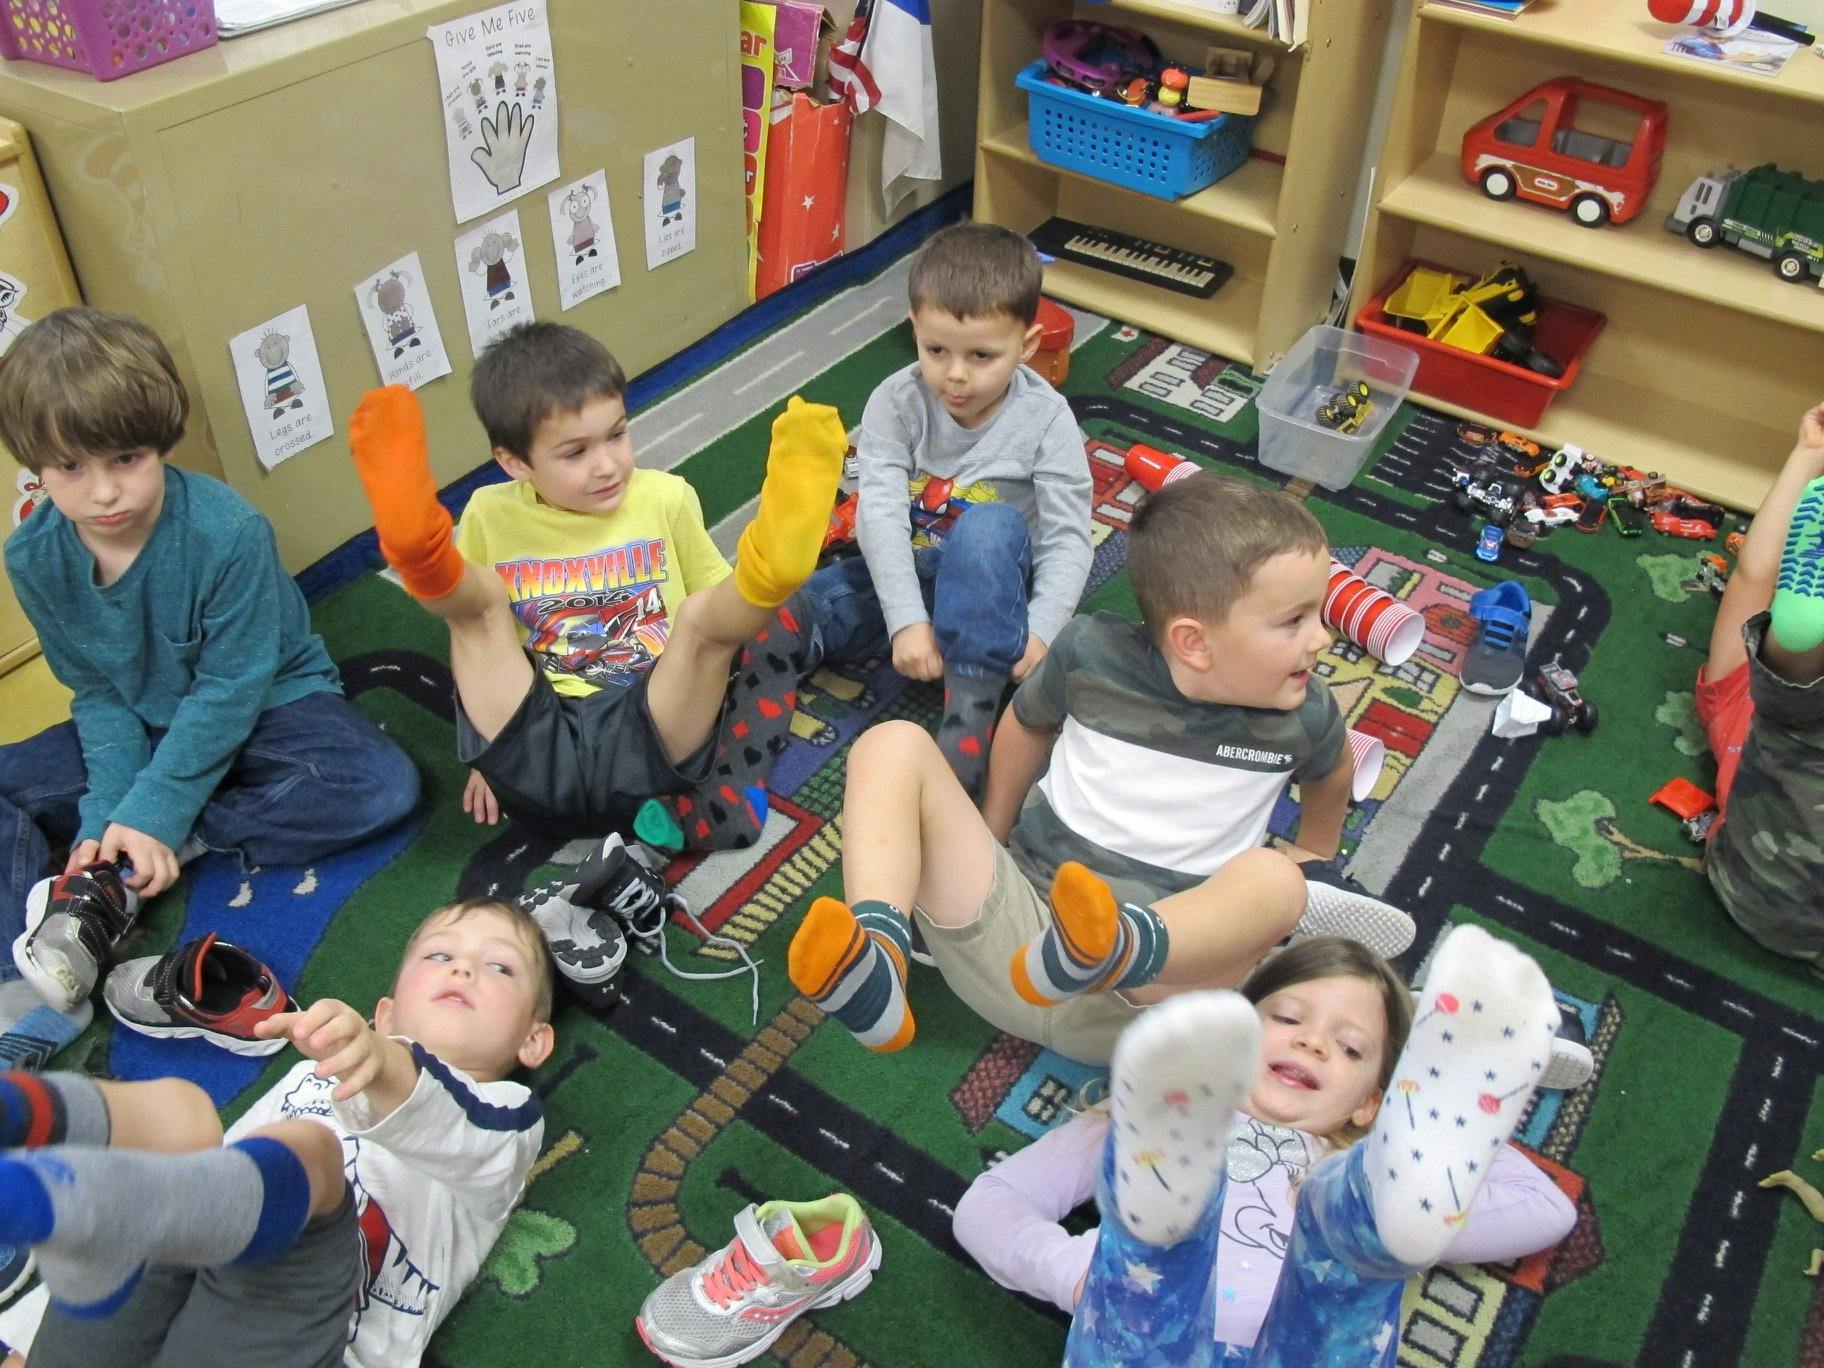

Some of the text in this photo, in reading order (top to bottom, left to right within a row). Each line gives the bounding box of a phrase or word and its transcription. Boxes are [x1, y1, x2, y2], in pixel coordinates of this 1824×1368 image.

[445, 8, 535, 47] Give Me Five
[590, 263, 603, 274] are
[488, 306, 520, 329] Ears are
[390, 350, 432, 380] Hands are
[269, 414, 312, 440] Legs are
[275, 429, 315, 456] crossed.
[496, 539, 668, 604] KNOXVILLE
[538, 590, 631, 616] 2014
[1216, 744, 1284, 765] ABERCROMBIE
